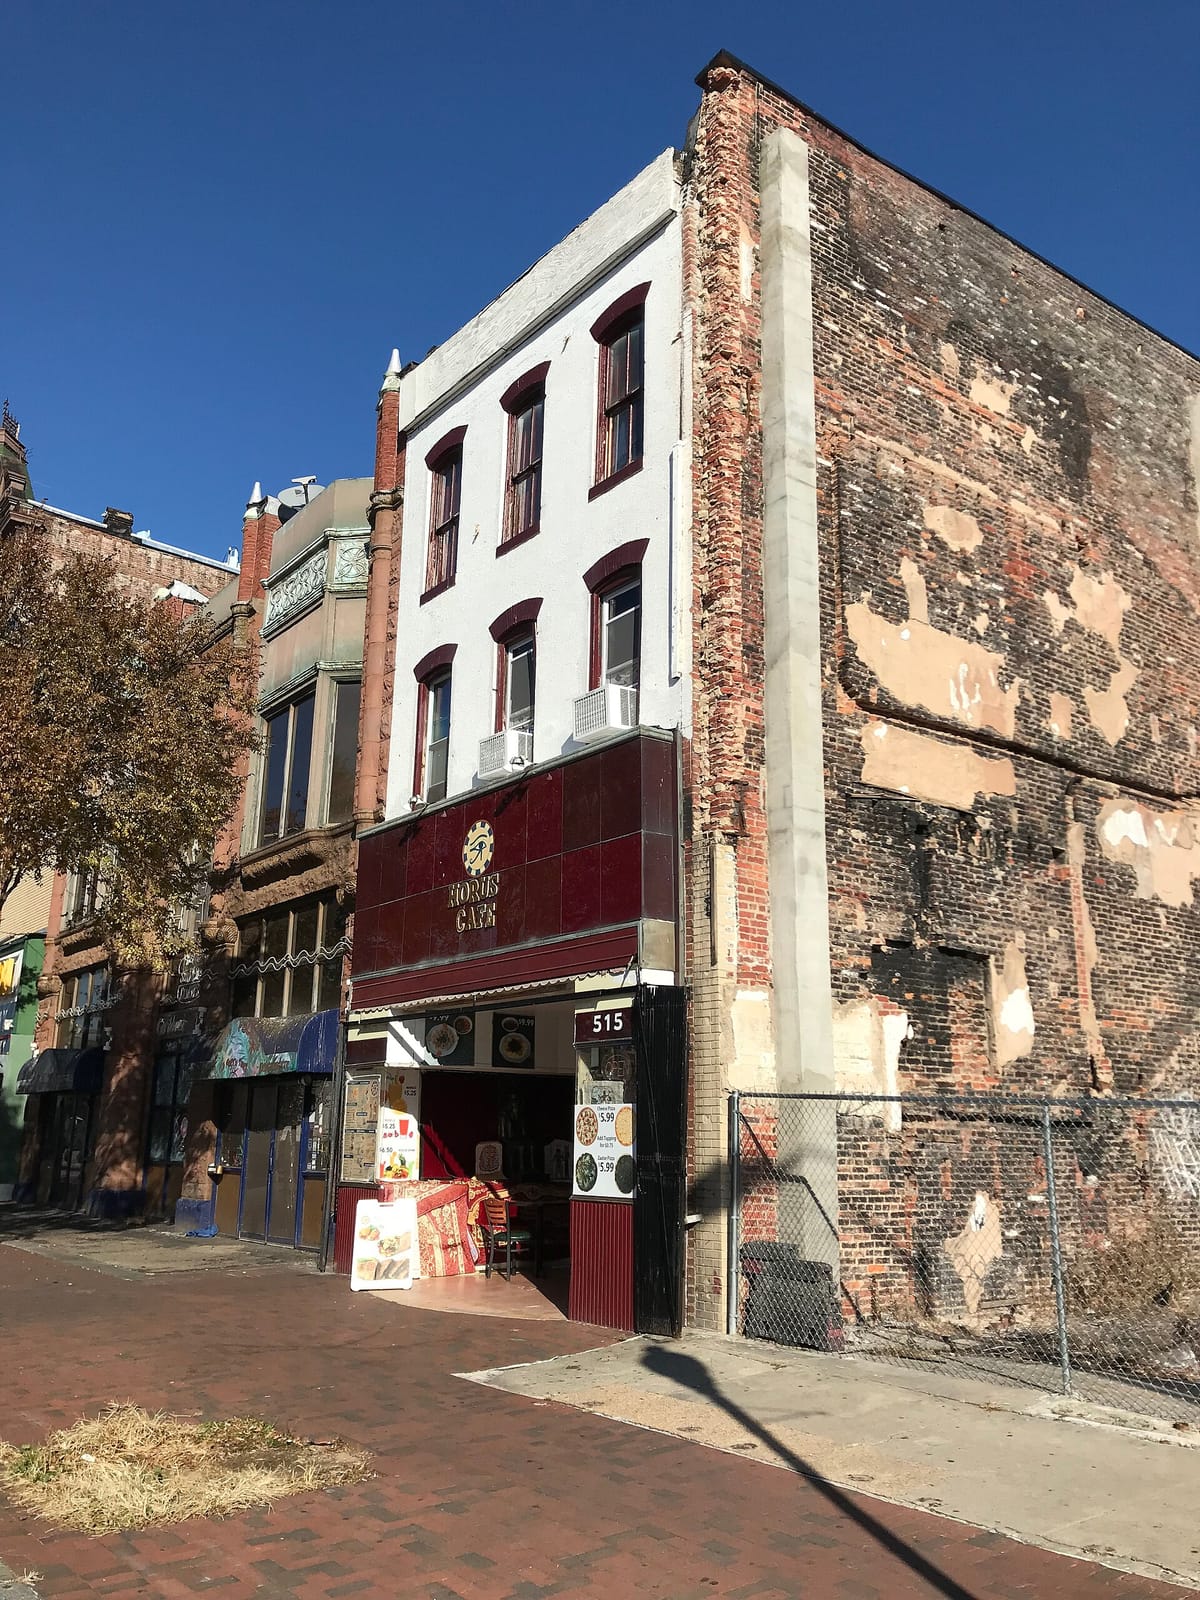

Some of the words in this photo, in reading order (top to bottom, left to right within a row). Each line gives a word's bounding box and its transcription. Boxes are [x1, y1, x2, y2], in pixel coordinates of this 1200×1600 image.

[448, 873, 500, 908] HORUS
[456, 902, 496, 933] CAFE
[593, 1012, 623, 1033] 515
